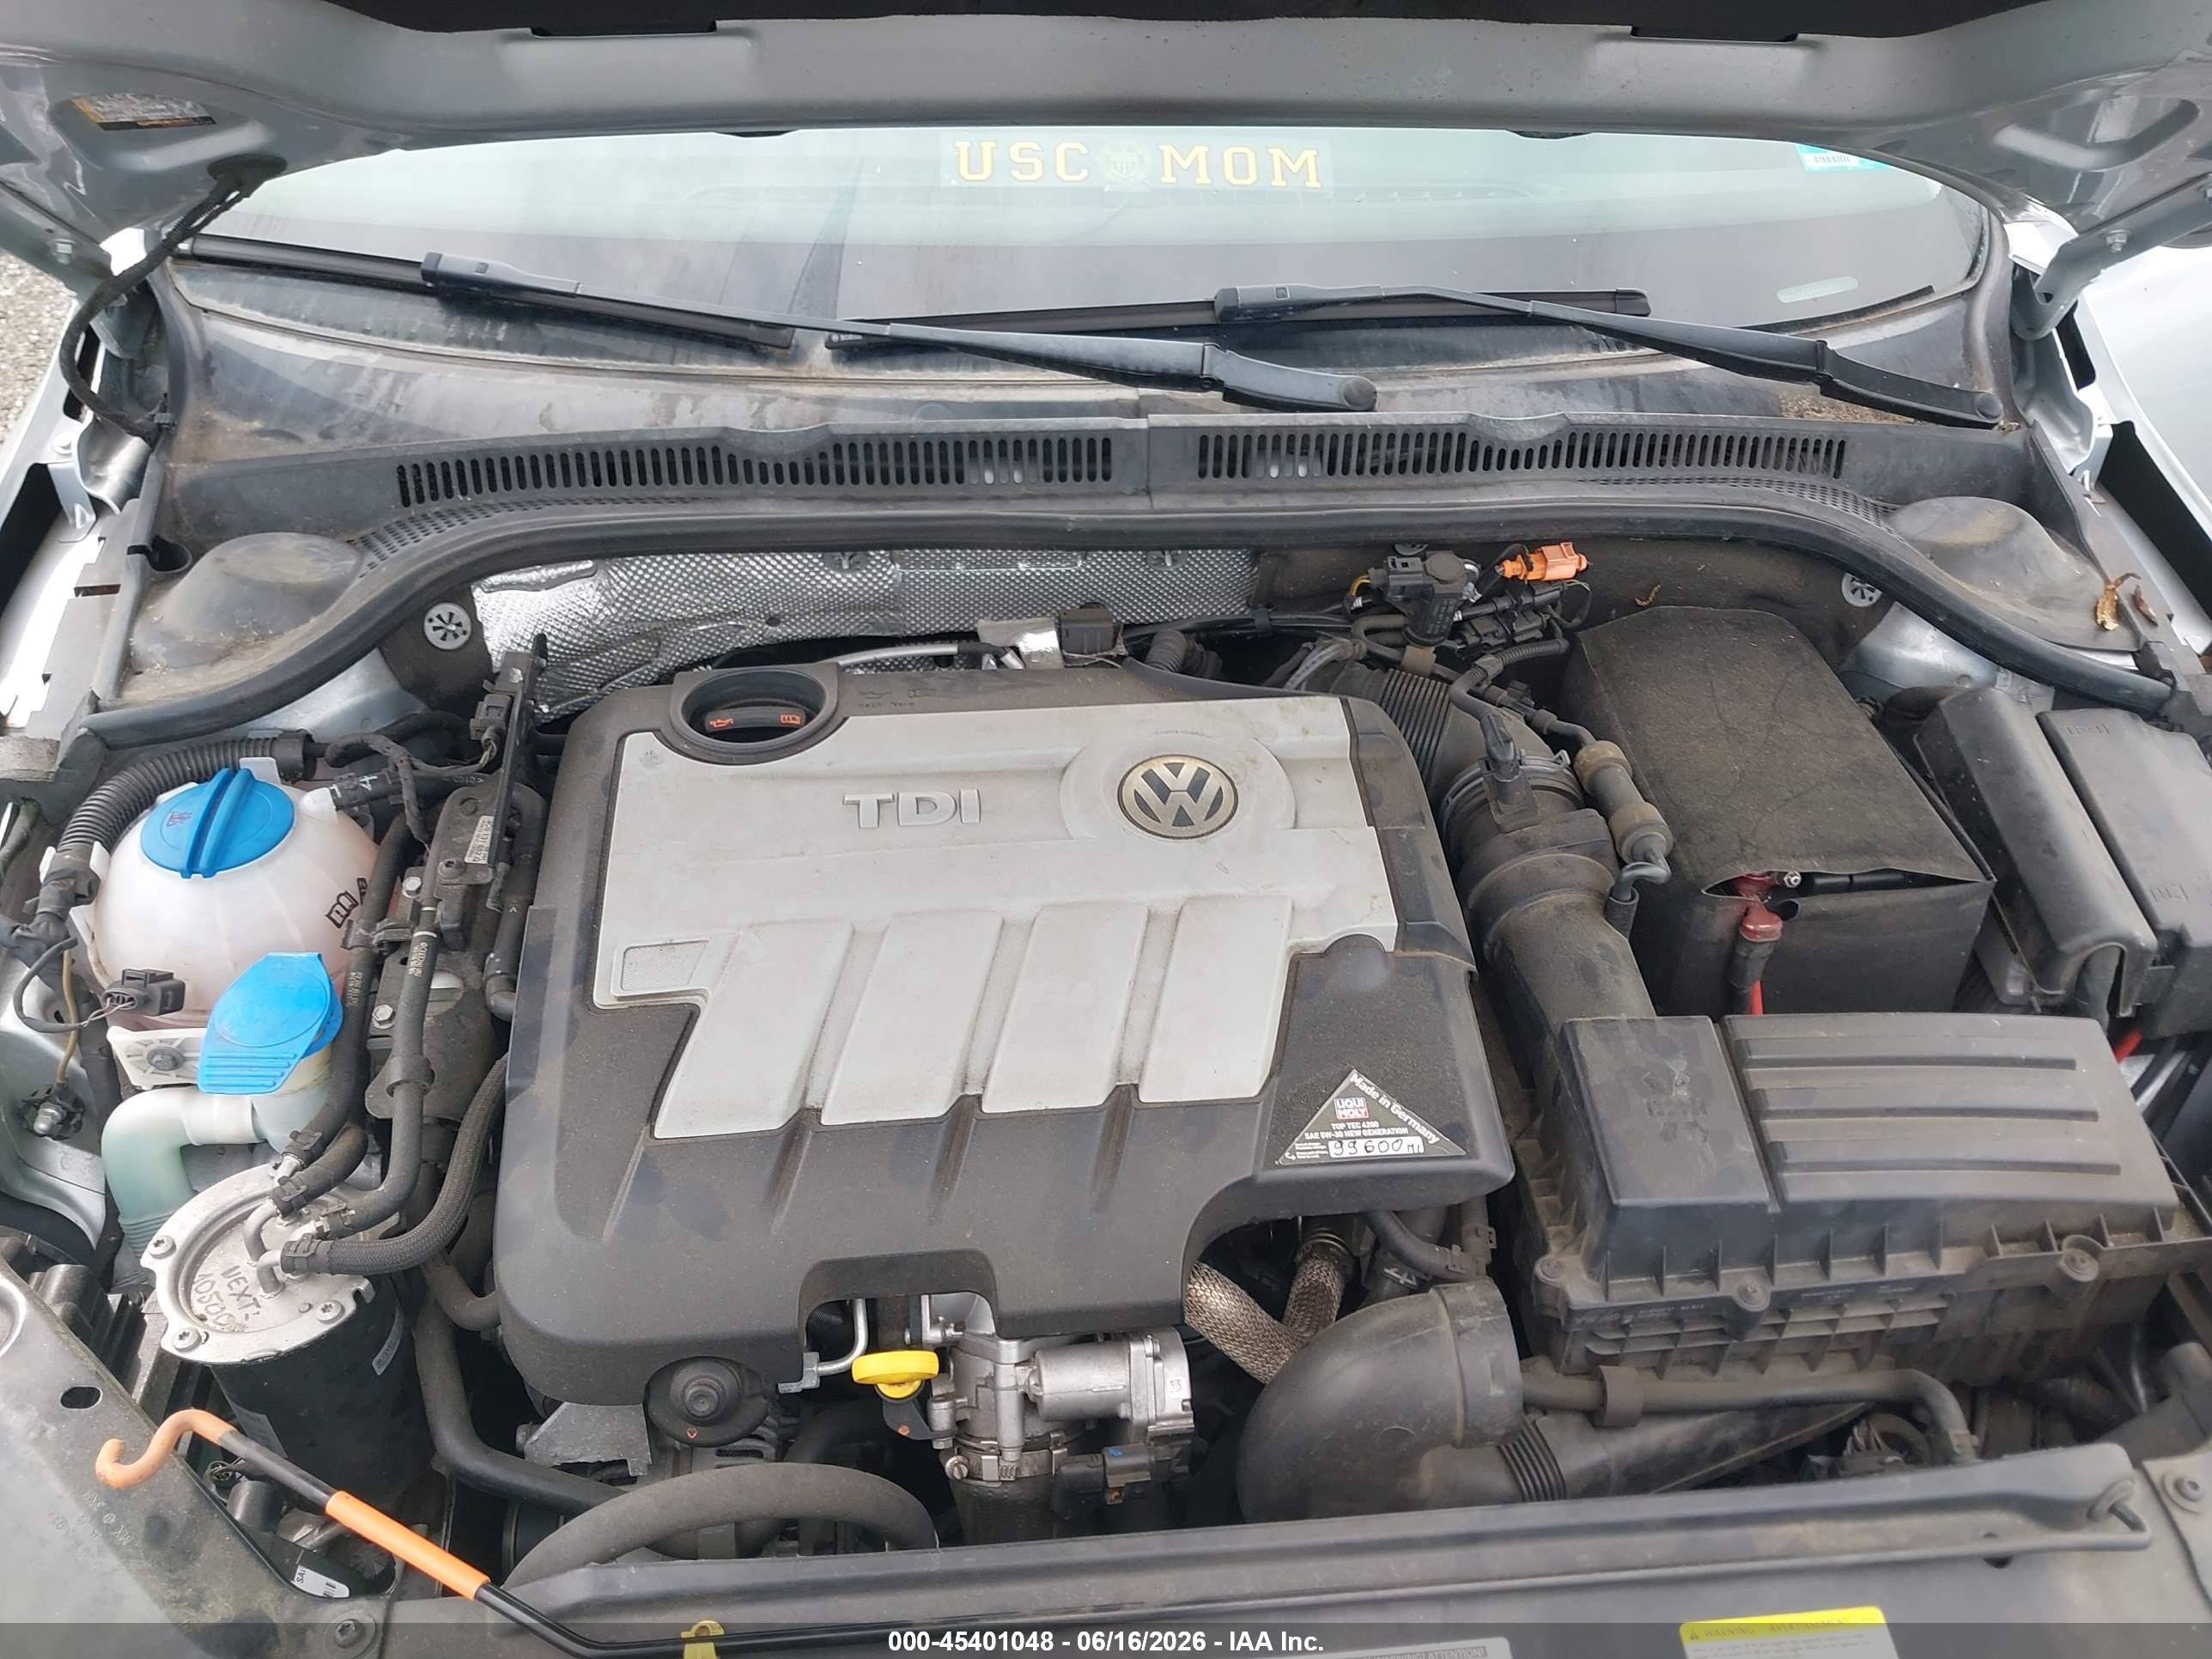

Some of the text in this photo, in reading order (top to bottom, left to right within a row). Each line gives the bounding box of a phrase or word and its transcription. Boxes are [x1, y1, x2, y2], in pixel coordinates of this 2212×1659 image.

[955, 140, 1321, 188] USC MOM
[842, 788, 981, 829] TDI
[1336, 1098, 1365, 1109] LIQUI
[1349, 1073, 1441, 1145] Made in Germany
[1337, 1108, 1368, 1119] MOLY
[1331, 1122, 1346, 1131] TOP
[1346, 1121, 1362, 1130] TEC
[1304, 1132, 1321, 1140] SAE
[1344, 1129, 1363, 1139] NEW
[1362, 1127, 1409, 1138] GENERATION
